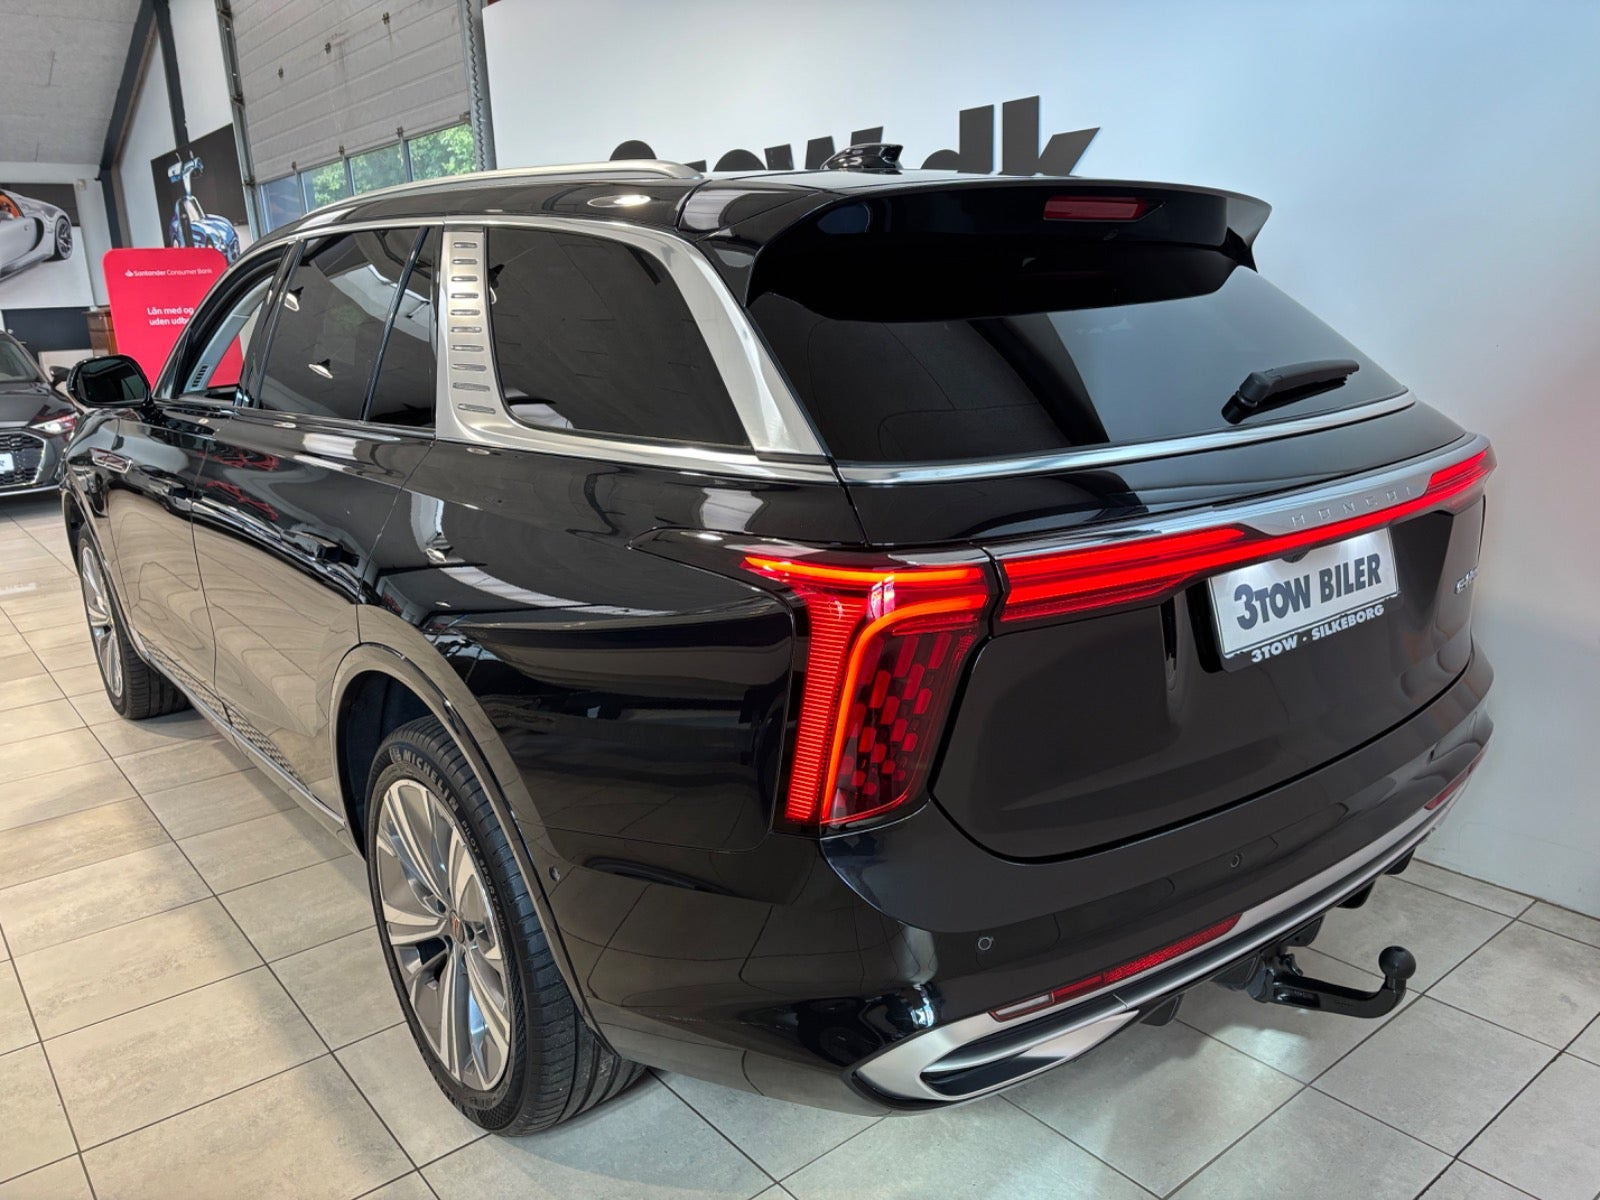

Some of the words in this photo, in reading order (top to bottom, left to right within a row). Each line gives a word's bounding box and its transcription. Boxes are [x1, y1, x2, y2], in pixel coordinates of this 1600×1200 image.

[133, 269, 166, 277] Santander
[197, 267, 213, 275] Bank
[147, 306, 163, 315] Lån
[164, 306, 182, 314] med
[183, 307, 194, 316] og
[149, 317, 170, 325] uden
[1319, 553, 1382, 604] BILER
[1311, 604, 1385, 641] SILKEBORG
[402, 749, 459, 812] MICHELIN
[462, 820, 480, 854] PILOT
